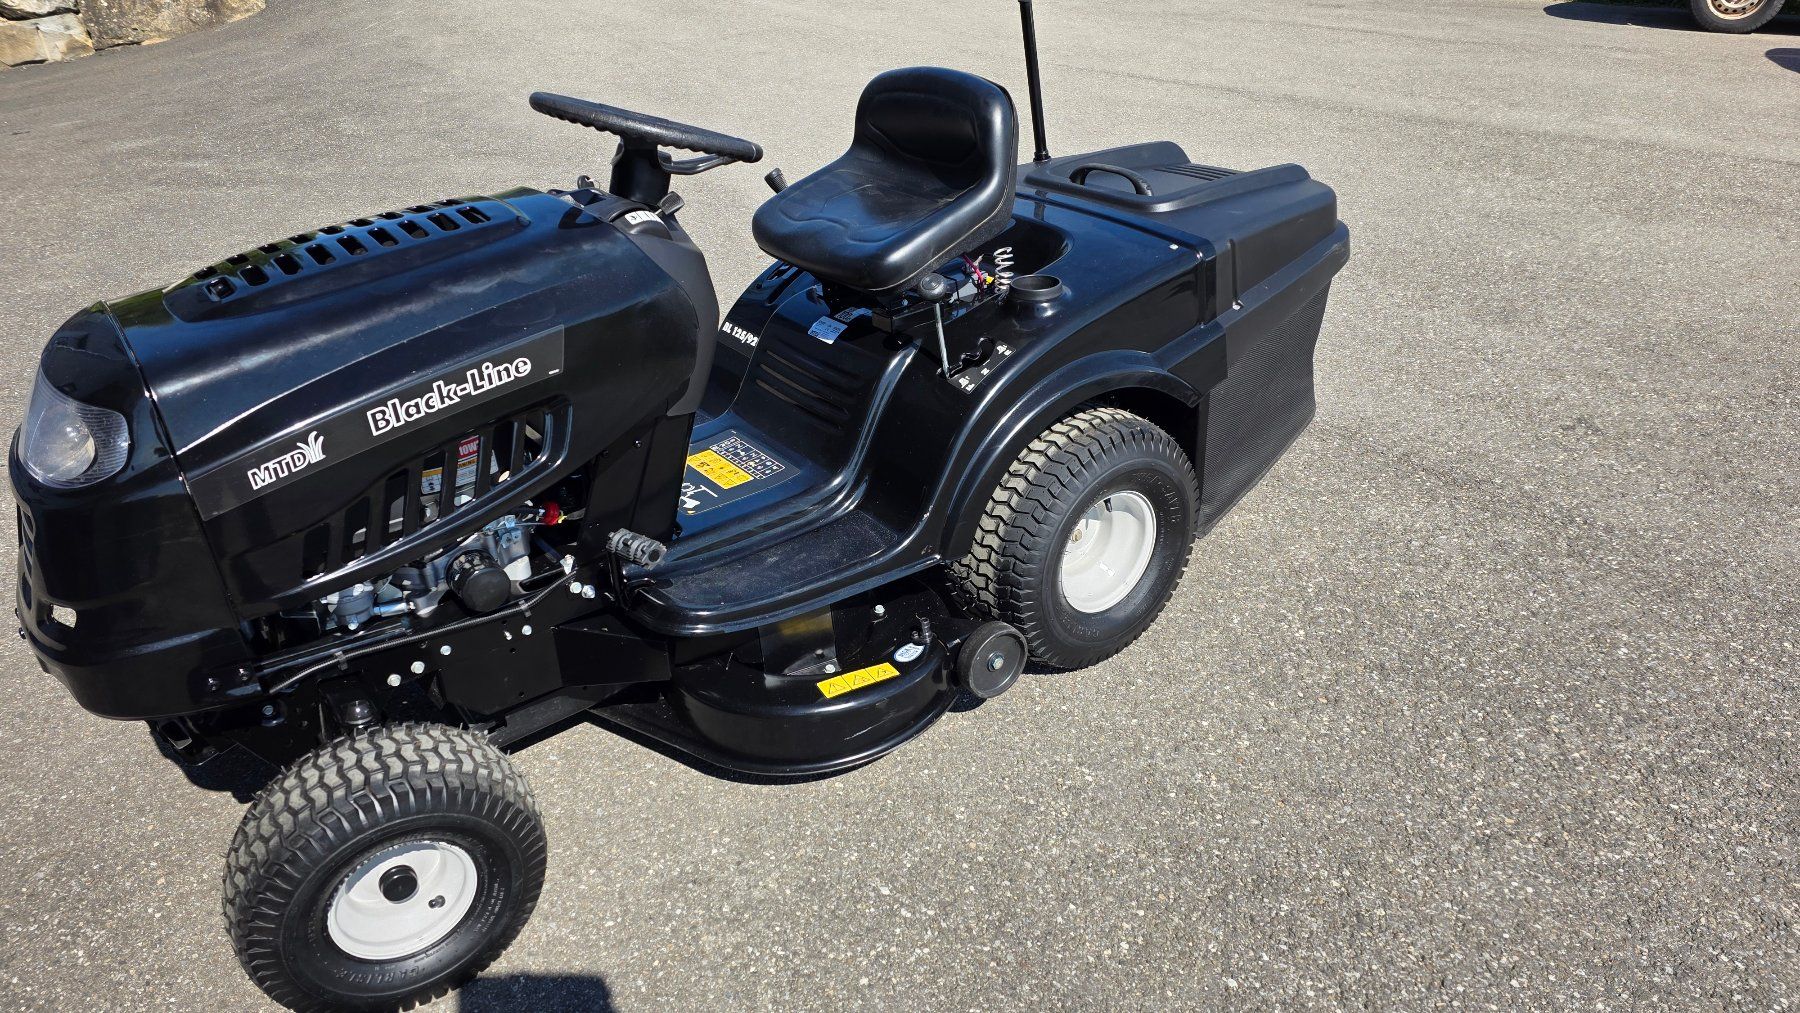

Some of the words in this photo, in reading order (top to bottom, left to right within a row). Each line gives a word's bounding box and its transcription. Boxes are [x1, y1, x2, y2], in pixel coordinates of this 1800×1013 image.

[732, 326, 759, 347] 125/92
[366, 357, 532, 436] Black-Line
[247, 449, 310, 490] MTD
